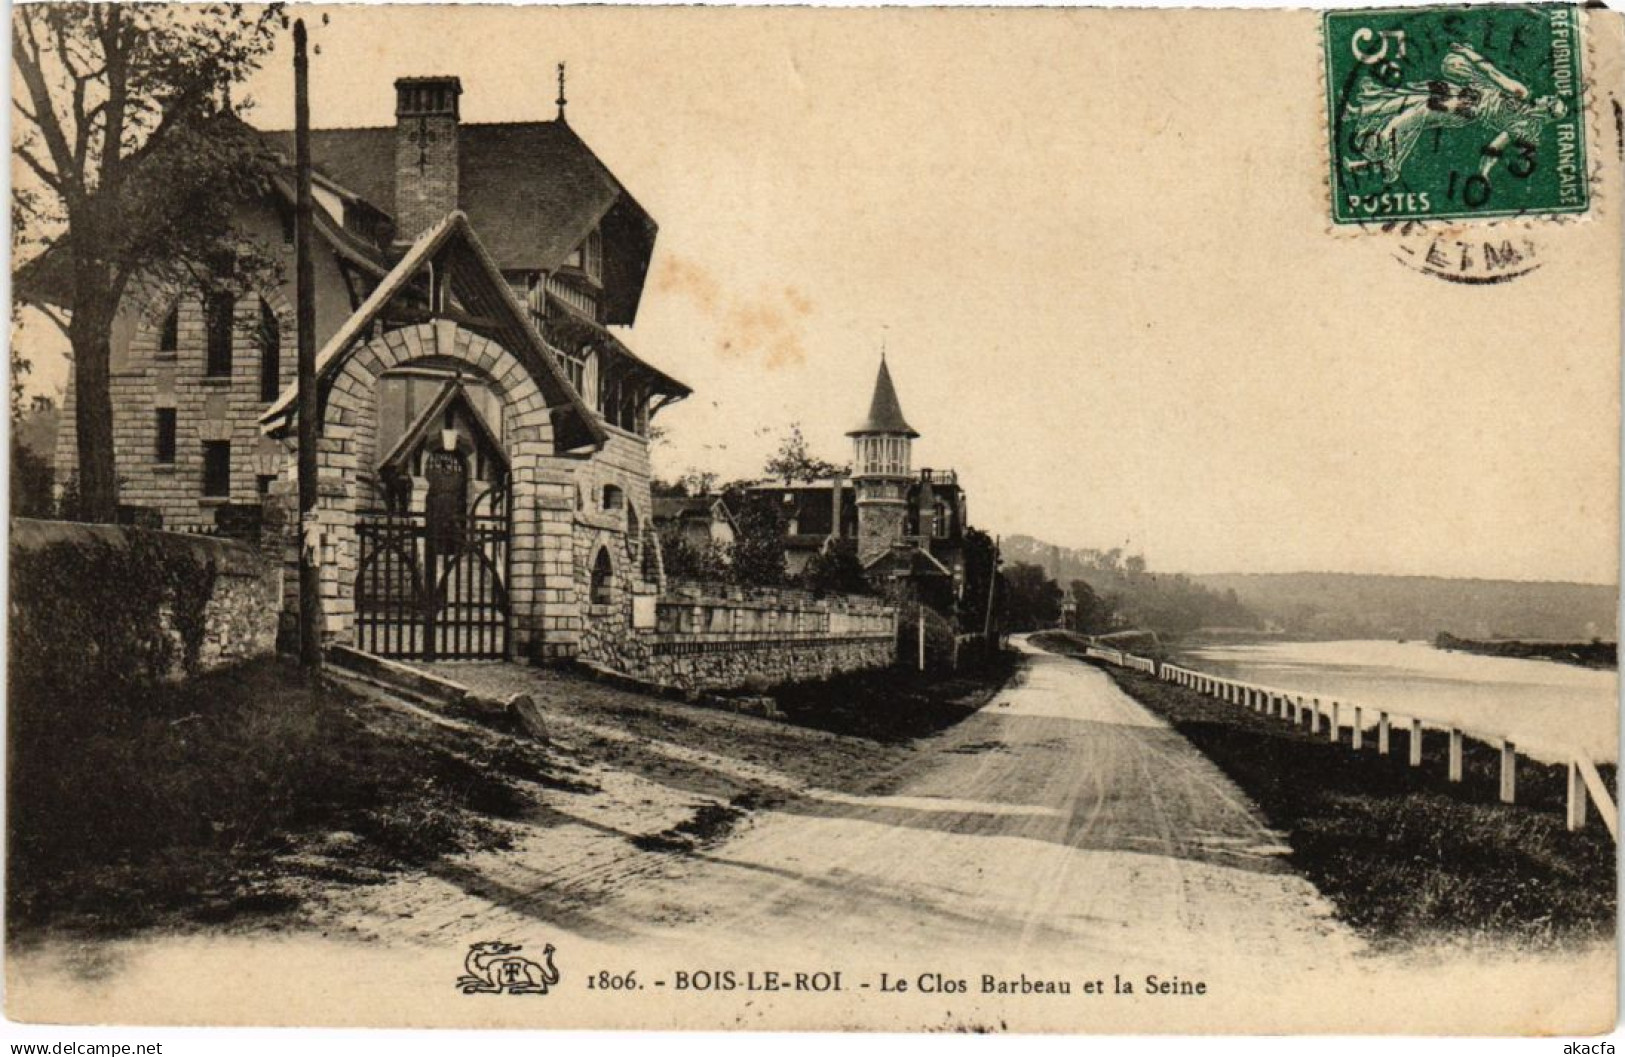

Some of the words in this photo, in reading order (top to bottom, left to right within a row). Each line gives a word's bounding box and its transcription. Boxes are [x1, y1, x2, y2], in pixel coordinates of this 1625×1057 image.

[1351, 26, 1405, 65] 5
[1347, 191, 1431, 214] POSTES
[586, 970, 644, 991] 1806.
[879, 972, 908, 993] Le
[917, 972, 968, 993] Clos
[980, 973, 1071, 995] Barbeau
[1083, 977, 1105, 995] et
[1114, 974, 1135, 995] la
[1145, 974, 1208, 996] Seine
